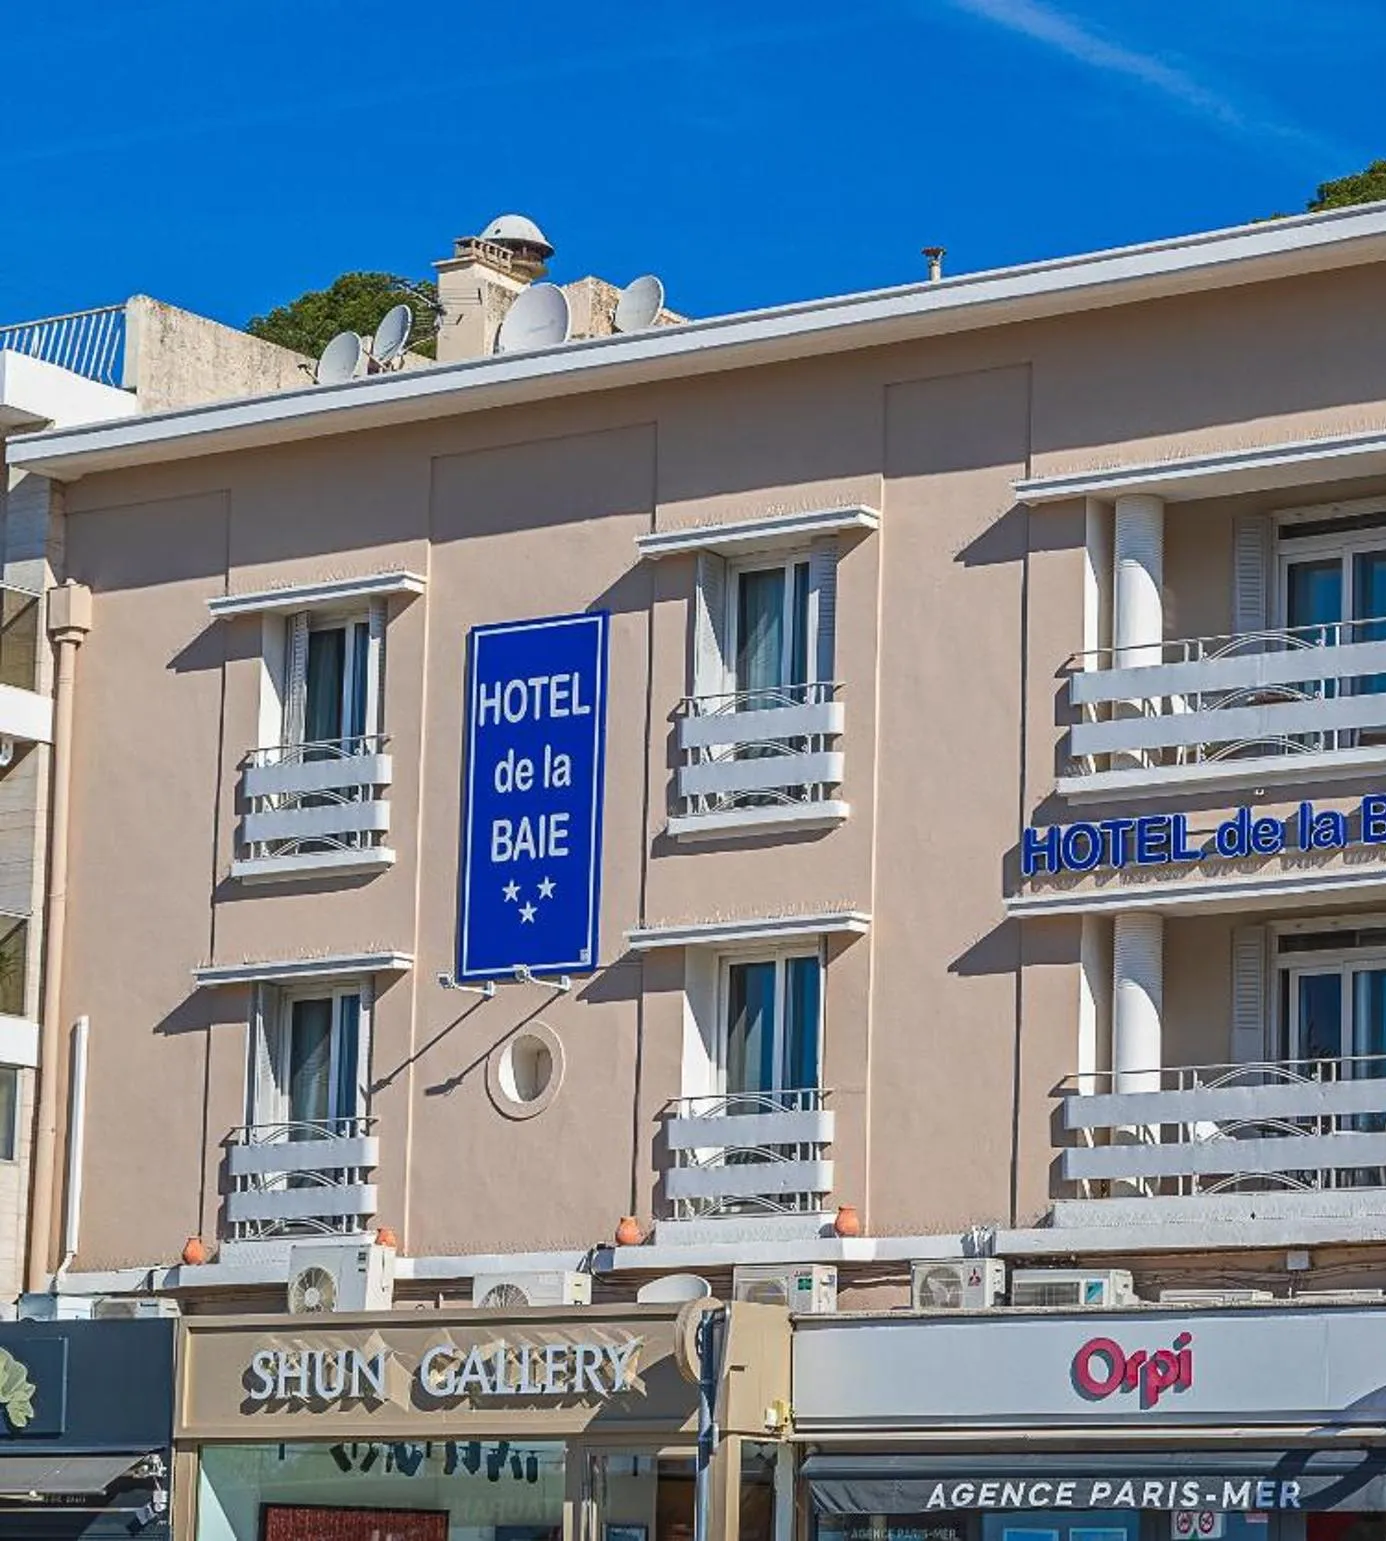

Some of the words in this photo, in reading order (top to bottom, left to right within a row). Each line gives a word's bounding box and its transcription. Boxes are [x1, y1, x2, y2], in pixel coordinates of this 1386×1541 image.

[478, 672, 591, 727] HOTEL
[494, 749, 534, 793] de
[544, 744, 572, 789] la
[491, 812, 570, 863] BAIE
[1021, 814, 1206, 875] HOTEL
[1217, 806, 1283, 857] de
[1299, 802, 1347, 851] la
[251, 1349, 387, 1401] SHUN
[420, 1336, 641, 1397] GALLERY
[1073, 1332, 1193, 1408] Orpi
[926, 1481, 1076, 1510] AGENCE
[1089, 1480, 1301, 1509] PARIS-MER
